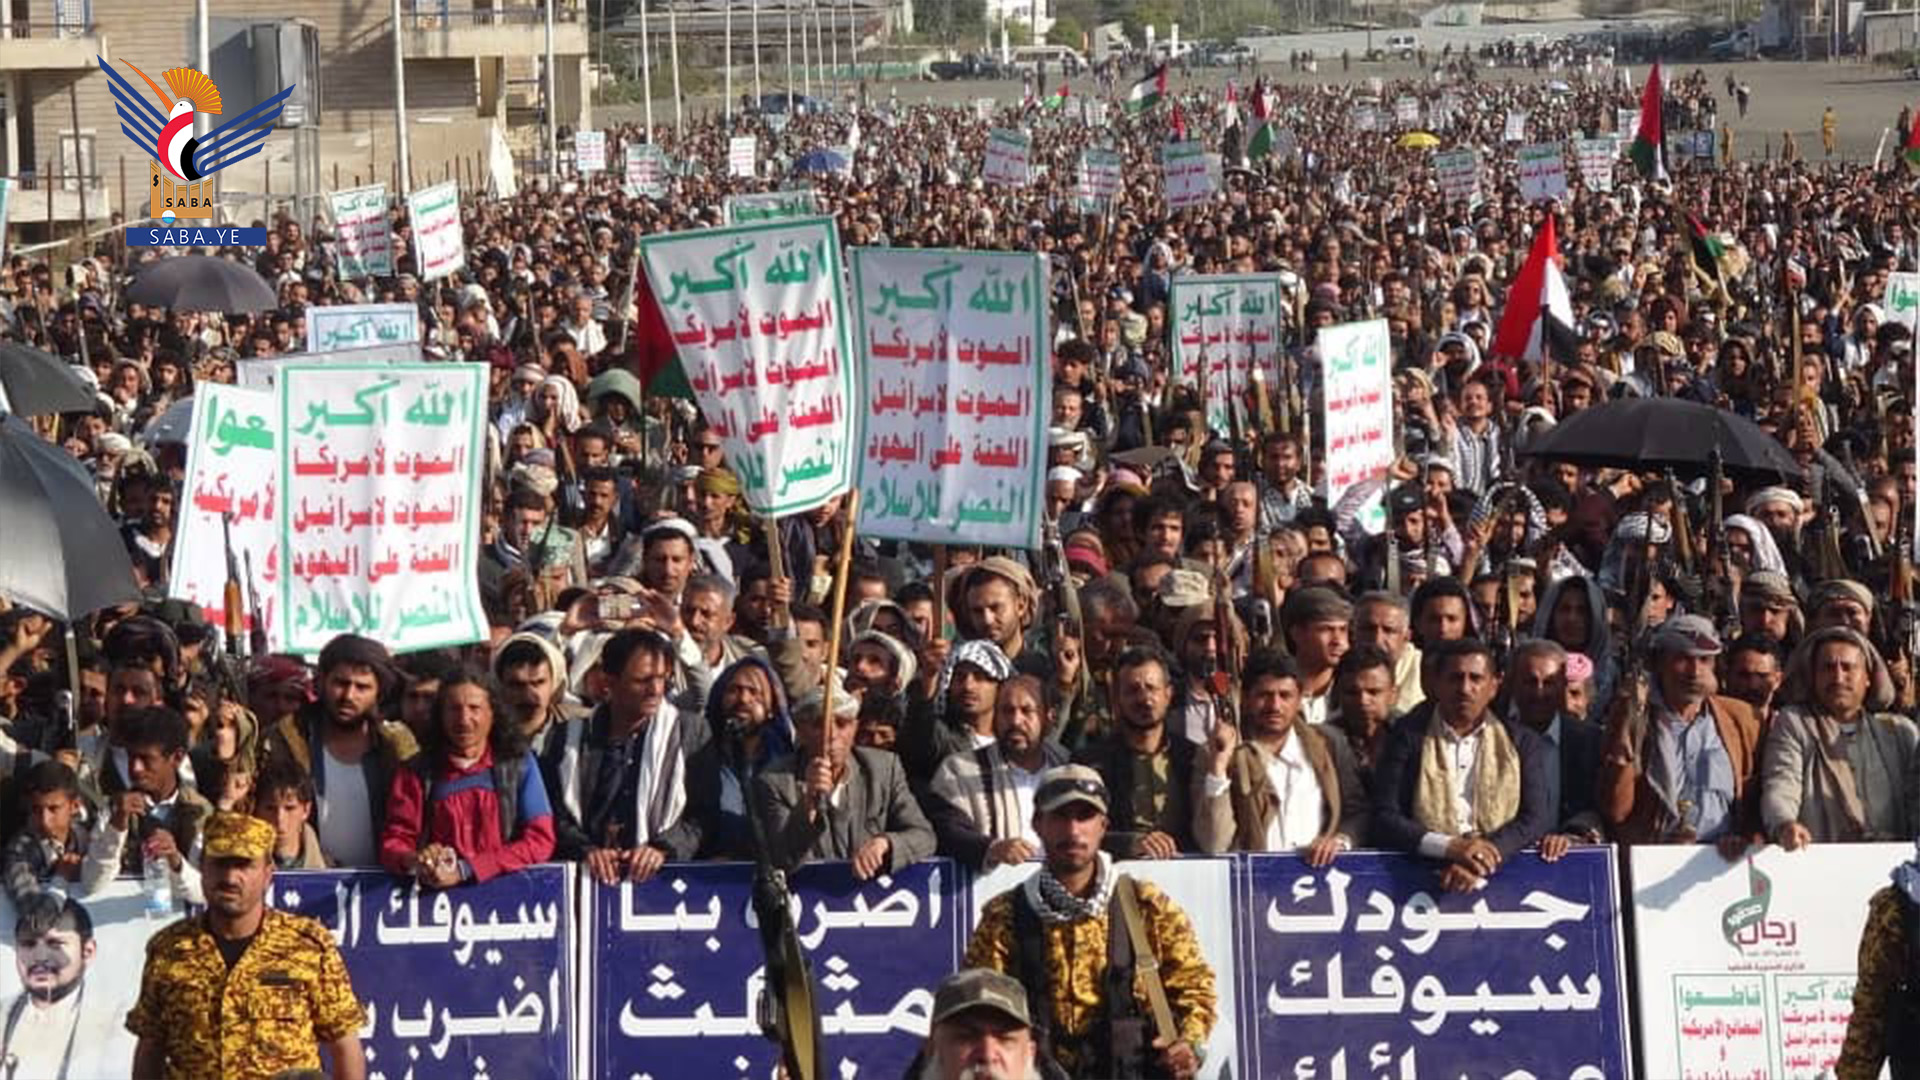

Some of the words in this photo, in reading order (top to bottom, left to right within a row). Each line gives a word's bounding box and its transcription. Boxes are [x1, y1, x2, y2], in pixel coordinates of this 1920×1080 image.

[661, 238, 755, 310] أكبر
[764, 238, 828, 285] الله
[869, 258, 963, 323] أكبر
[968, 264, 1031, 315] الله
[1240, 290, 1274, 315] الله
[377, 317, 408, 340] الله
[674, 302, 751, 350] لأمريك
[759, 299, 832, 341] الموت
[870, 324, 948, 368] لأمريكا
[957, 335, 1031, 371] الموت
[766, 348, 838, 388] الموت
[293, 373, 400, 442] أكبر
[403, 379, 469, 426] الله
[788, 396, 843, 430] اللعنة
[955, 387, 1031, 424] الموت
[746, 406, 779, 443] على
[293, 439, 386, 483] لأمريكا
[393, 445, 465, 483] الموت
[776, 437, 843, 497] النصر
[868, 431, 924, 469] اليهود
[930, 432, 962, 471] على
[972, 435, 1028, 469] اللعنة
[393, 496, 463, 532] الموت
[949, 479, 1026, 533] النصر
[293, 544, 359, 584] اليهود
[367, 546, 399, 584] على
[410, 543, 460, 574] اللعنة
[392, 585, 463, 641] النصر
[377, 882, 559, 966] سيوفك
[620, 878, 722, 953] بنا
[1267, 869, 1591, 955] جنودك
[1736, 919, 1797, 948] رجال
[1267, 945, 1603, 1036] سيوفك
[392, 967, 561, 1061] اضرب
